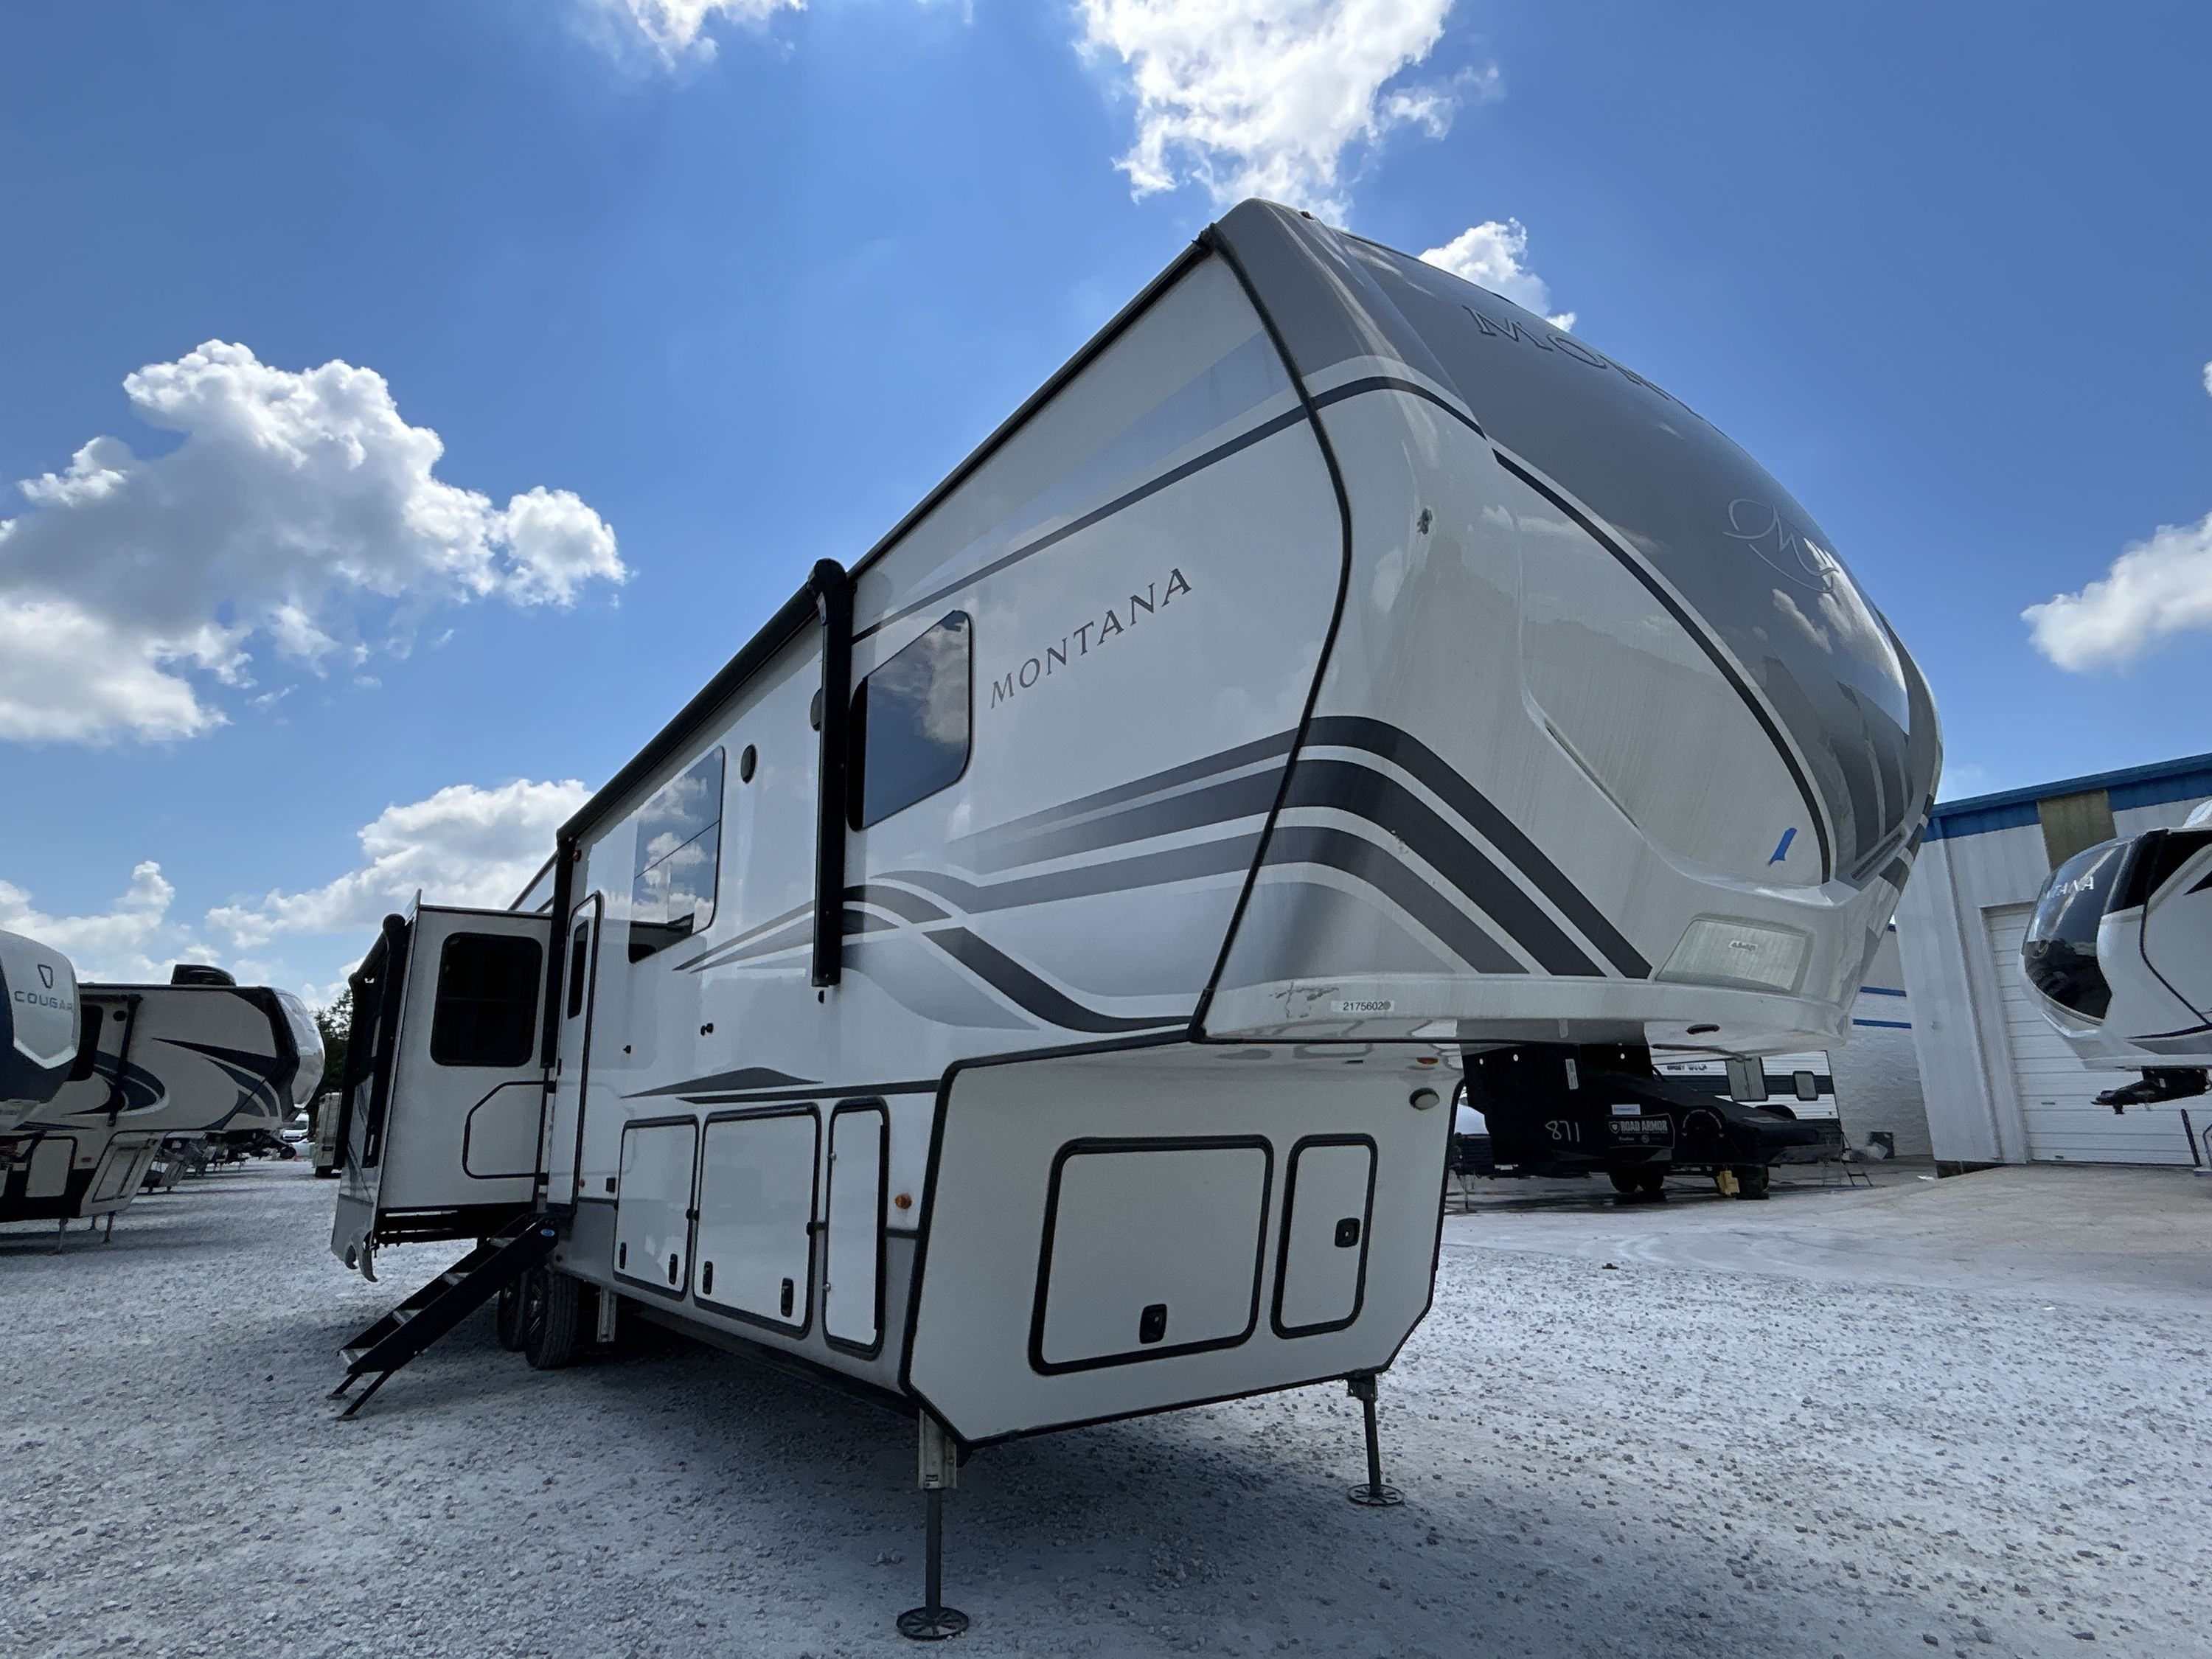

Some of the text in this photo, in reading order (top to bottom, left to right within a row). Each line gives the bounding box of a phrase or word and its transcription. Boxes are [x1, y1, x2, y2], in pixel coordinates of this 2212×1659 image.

[990, 568, 1192, 709] MONTANA
[14, 990, 73, 1012] COUGAR
[1545, 1120, 1580, 1143] 871
[1621, 1120, 1668, 1132] ROAD ARMOR
